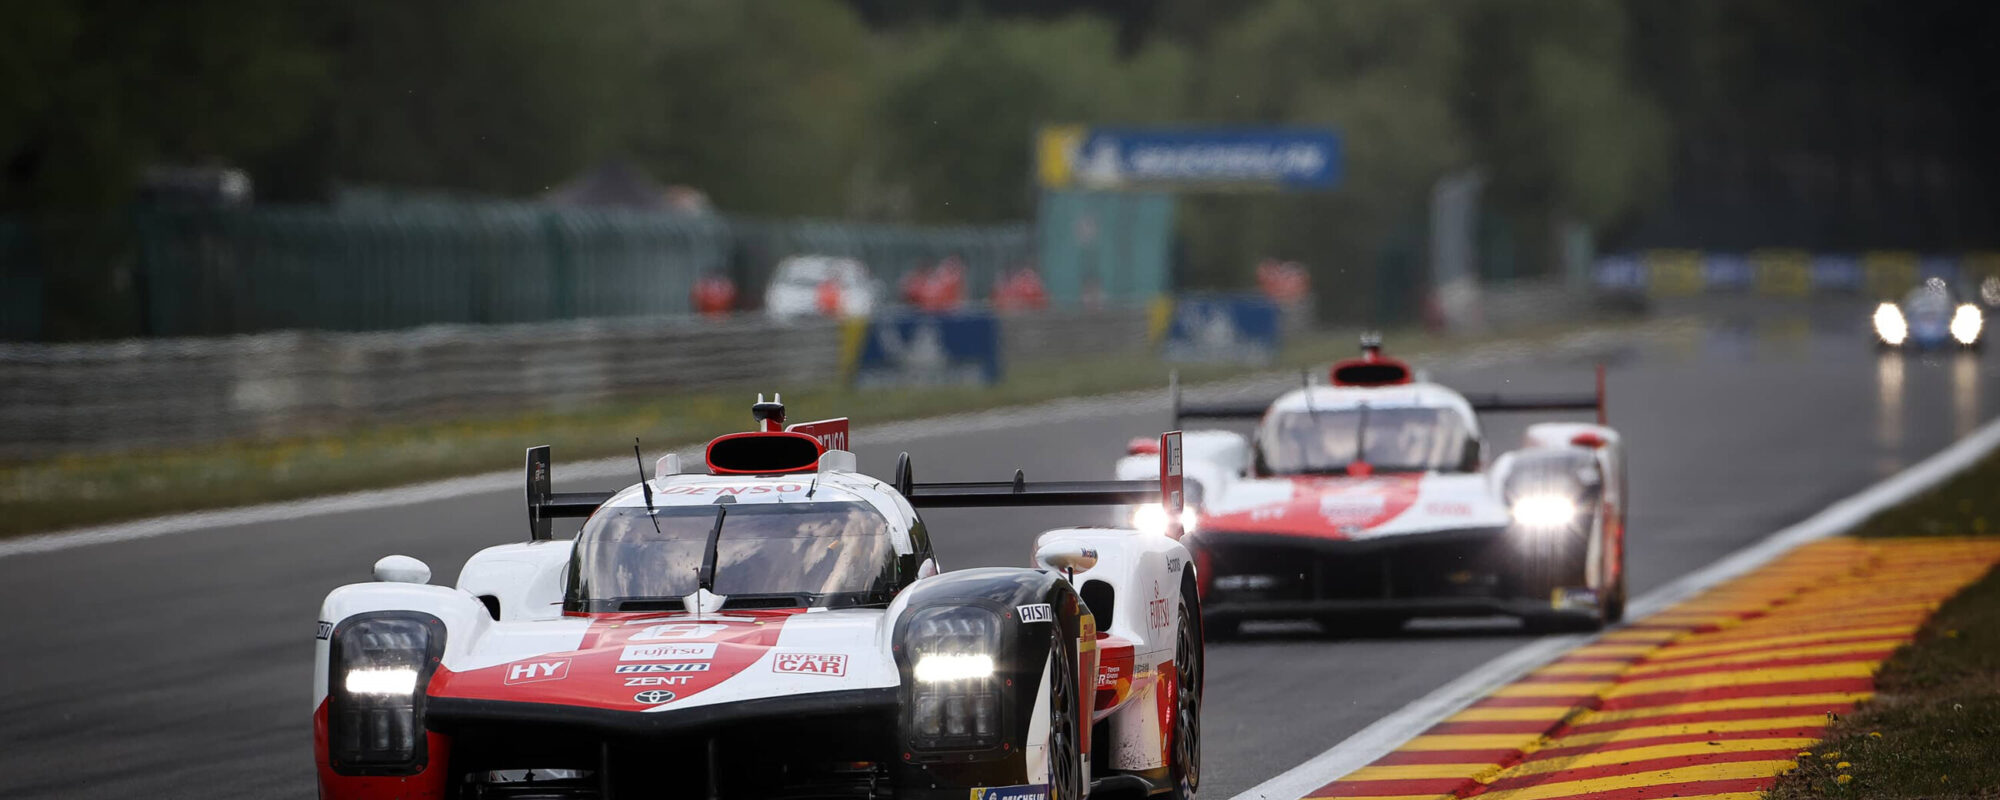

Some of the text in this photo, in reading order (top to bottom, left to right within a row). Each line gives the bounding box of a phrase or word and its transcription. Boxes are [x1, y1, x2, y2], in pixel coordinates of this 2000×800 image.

[660, 484, 801, 496] DENSO
[1021, 605, 1052, 621] AISIN
[627, 623, 729, 641] 8
[633, 646, 704, 657] FUJITSU
[780, 654, 842, 662] HYPER
[510, 661, 566, 680] HY
[617, 663, 708, 673] AISIN
[779, 660, 840, 674] CAR
[624, 675, 694, 686] ZENT
